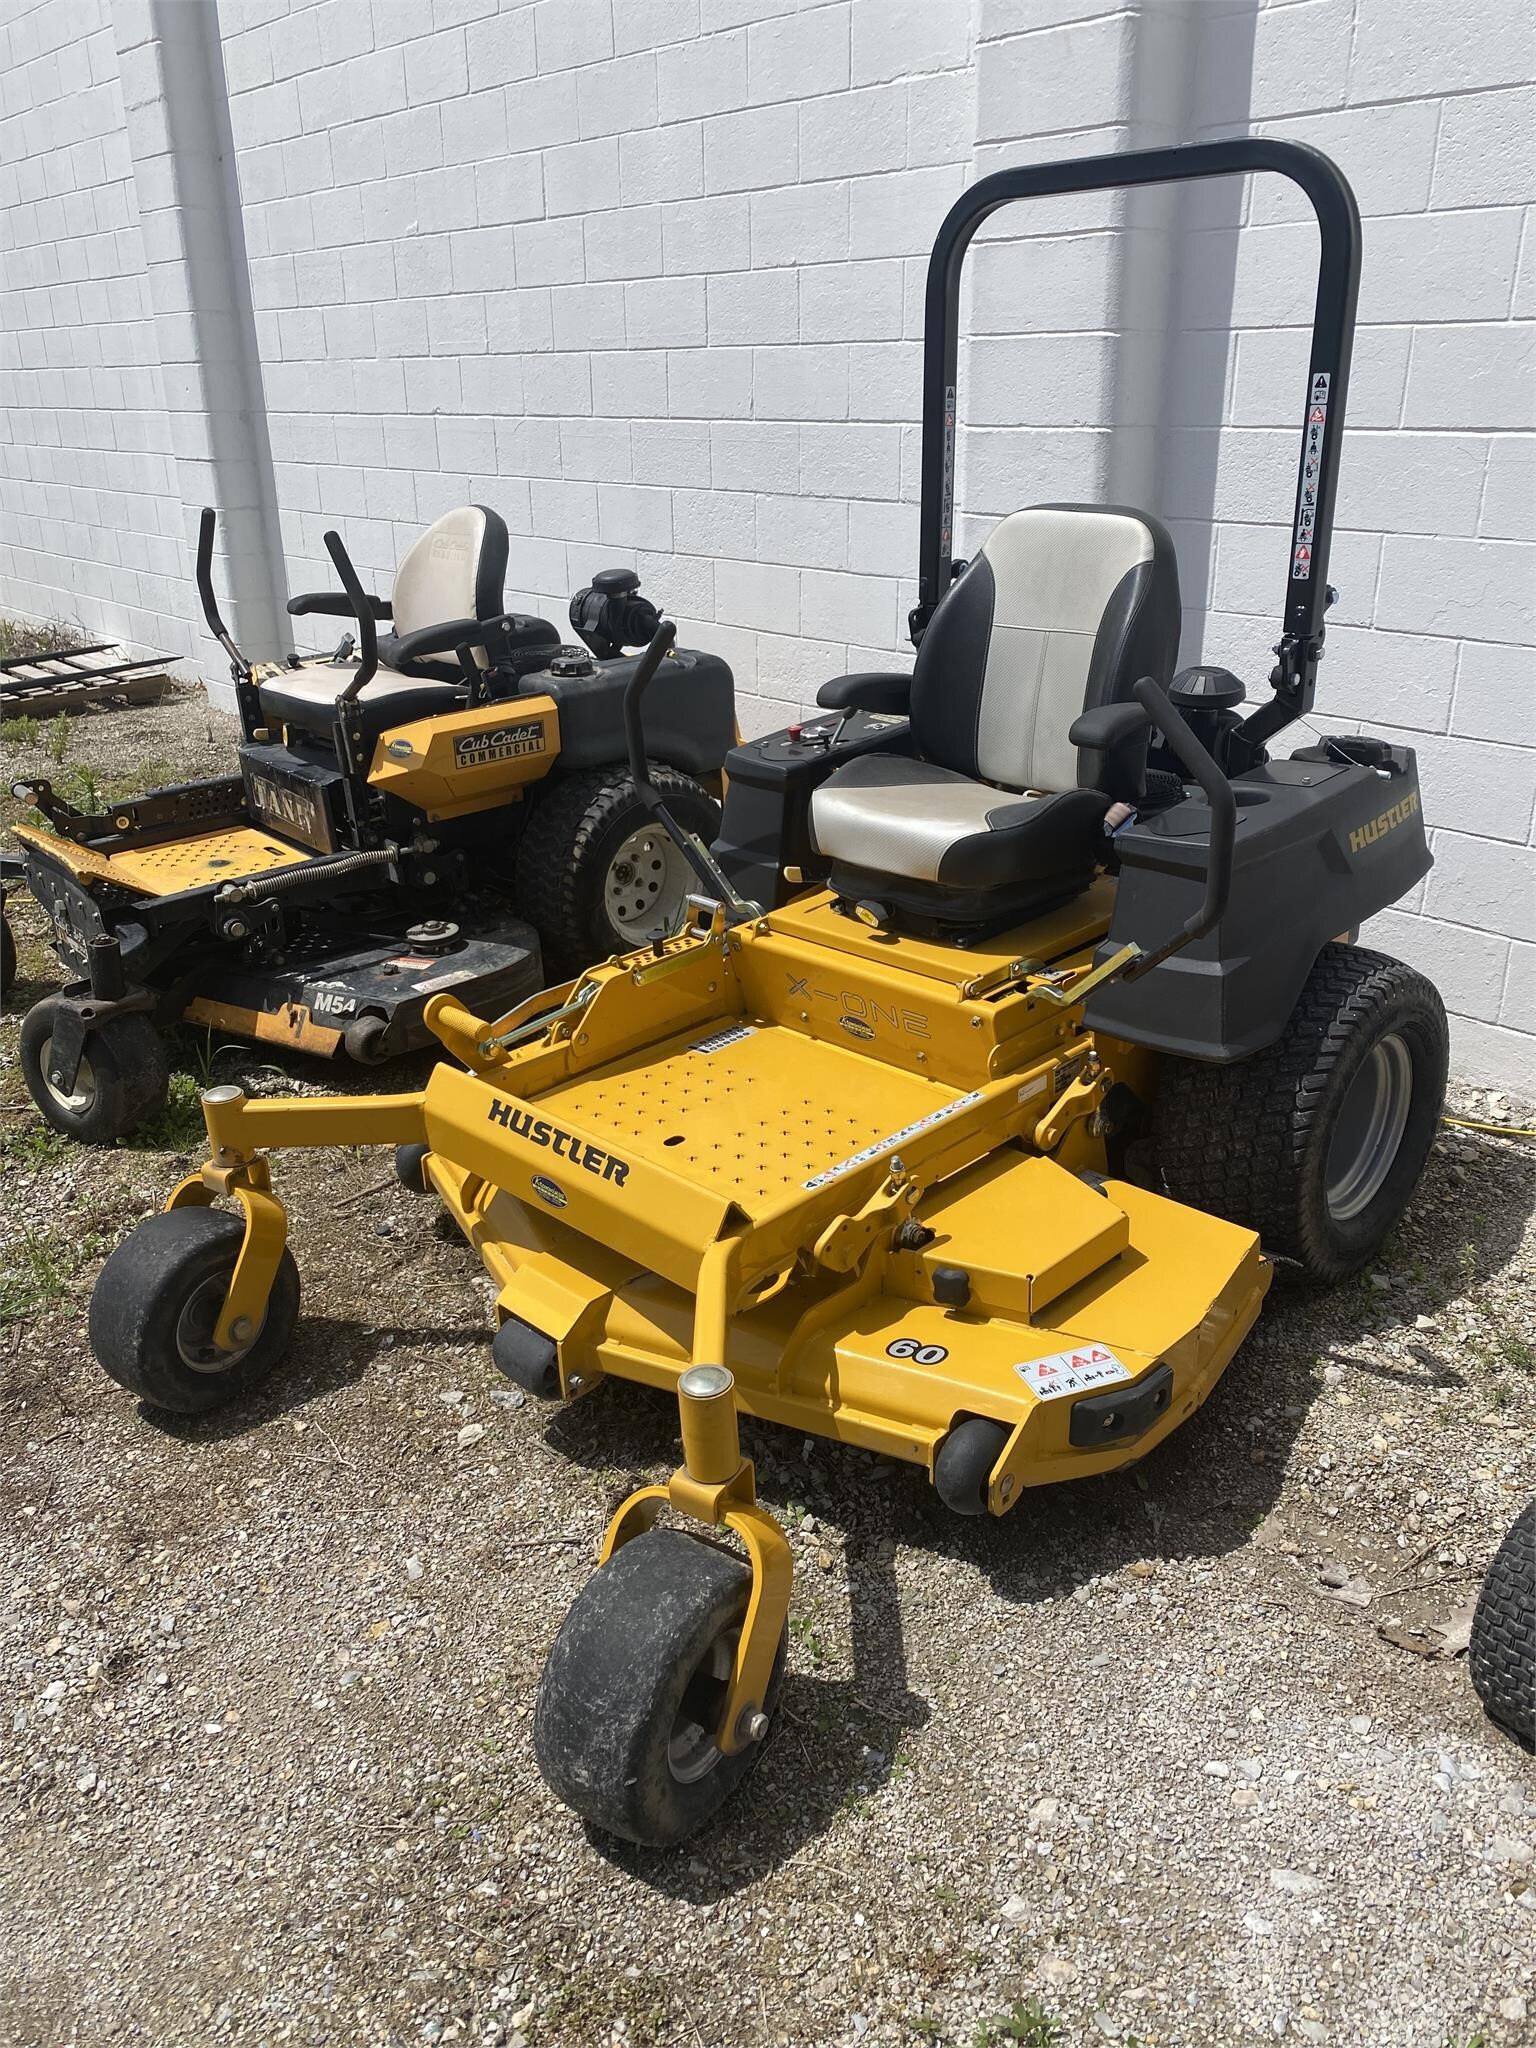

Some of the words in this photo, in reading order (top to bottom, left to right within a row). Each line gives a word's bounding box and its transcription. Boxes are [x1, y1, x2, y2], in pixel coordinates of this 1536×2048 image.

[459, 736, 490, 753] Cub
[490, 725, 540, 747] Cadet
[460, 739, 542, 766] COMMERCIAL
[1348, 791, 1419, 854] HUSTLER
[314, 992, 357, 1015] M54
[786, 973, 932, 1040] X-ONE
[487, 1098, 630, 1188] HUSTLER
[885, 1337, 949, 1366] 60
